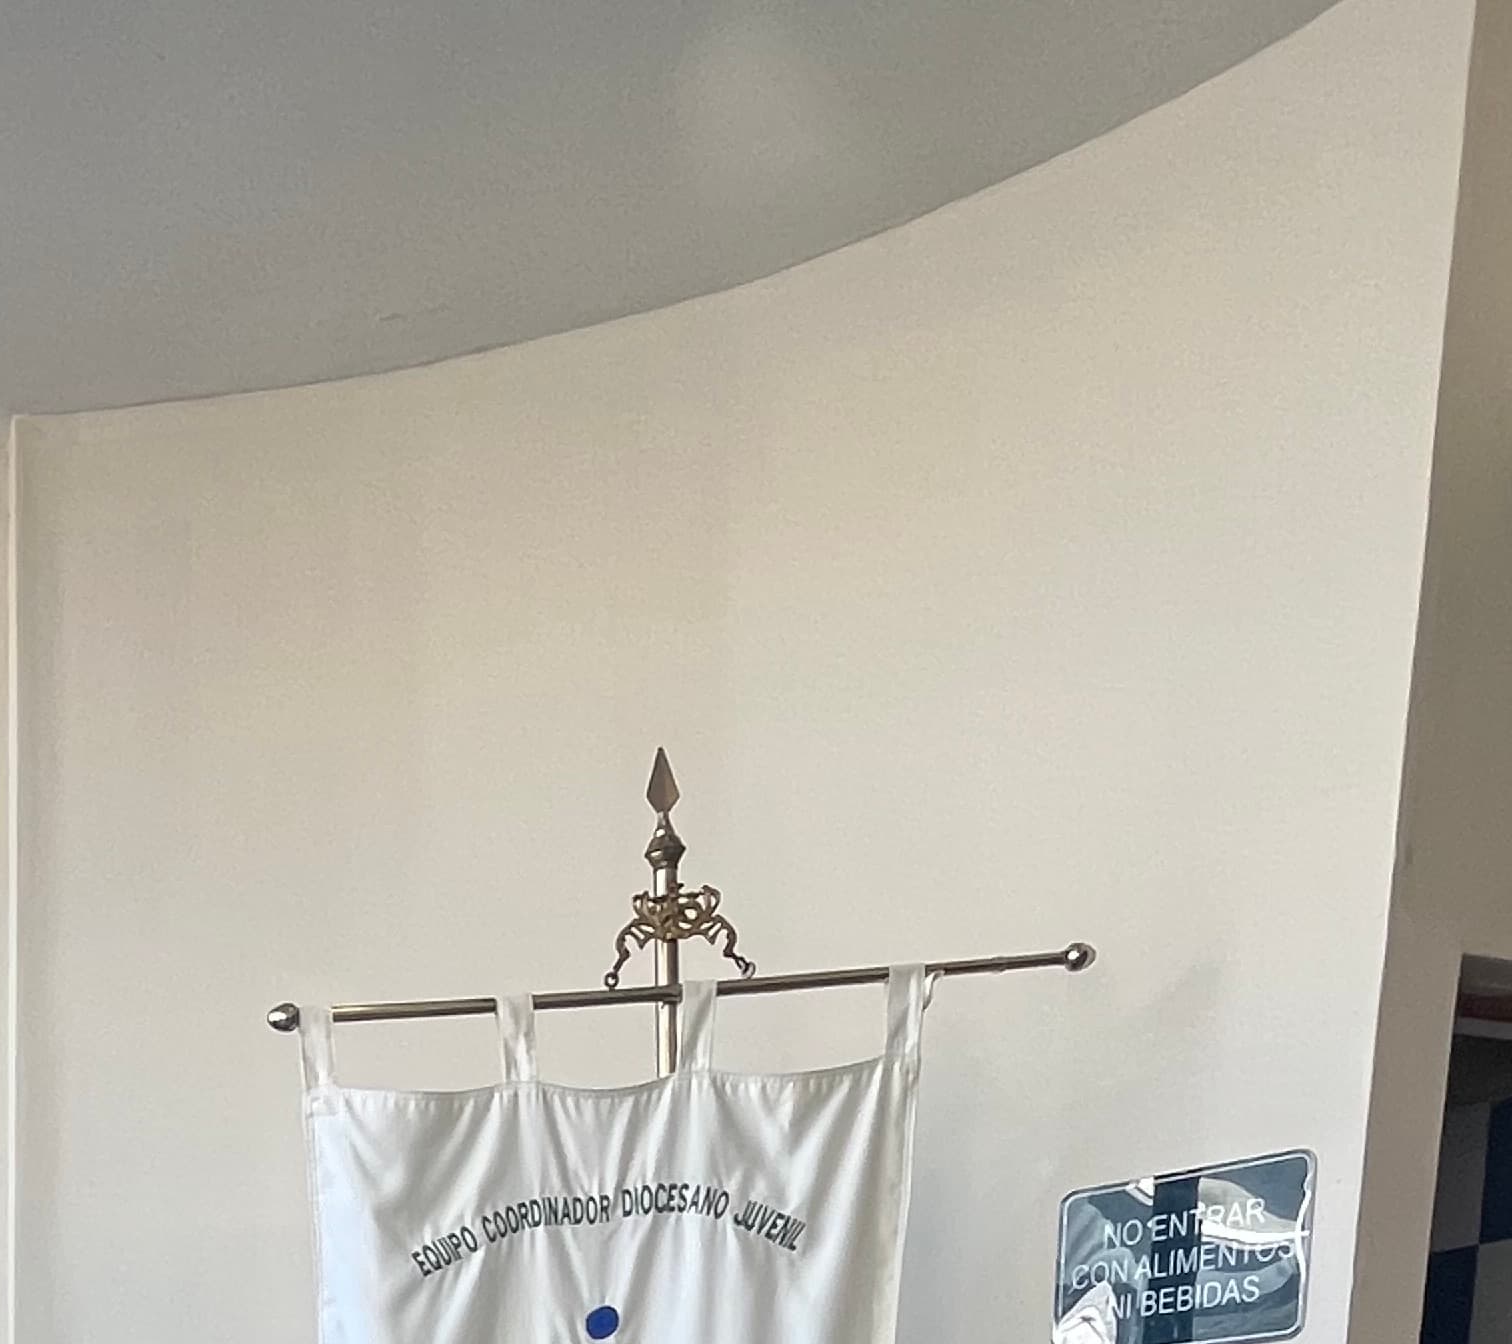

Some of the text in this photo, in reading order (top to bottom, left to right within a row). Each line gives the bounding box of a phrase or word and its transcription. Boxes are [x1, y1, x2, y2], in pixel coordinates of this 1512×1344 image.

[412, 1183, 806, 1277] EQUIPO COORDINADOR DIOCESANO JUVENIL
[1104, 1198, 1265, 1248] NO ENTRAR
[1072, 1241, 1294, 1289] CON ALIMENTOS
[1140, 1275, 1259, 1317] BEBIDAS
